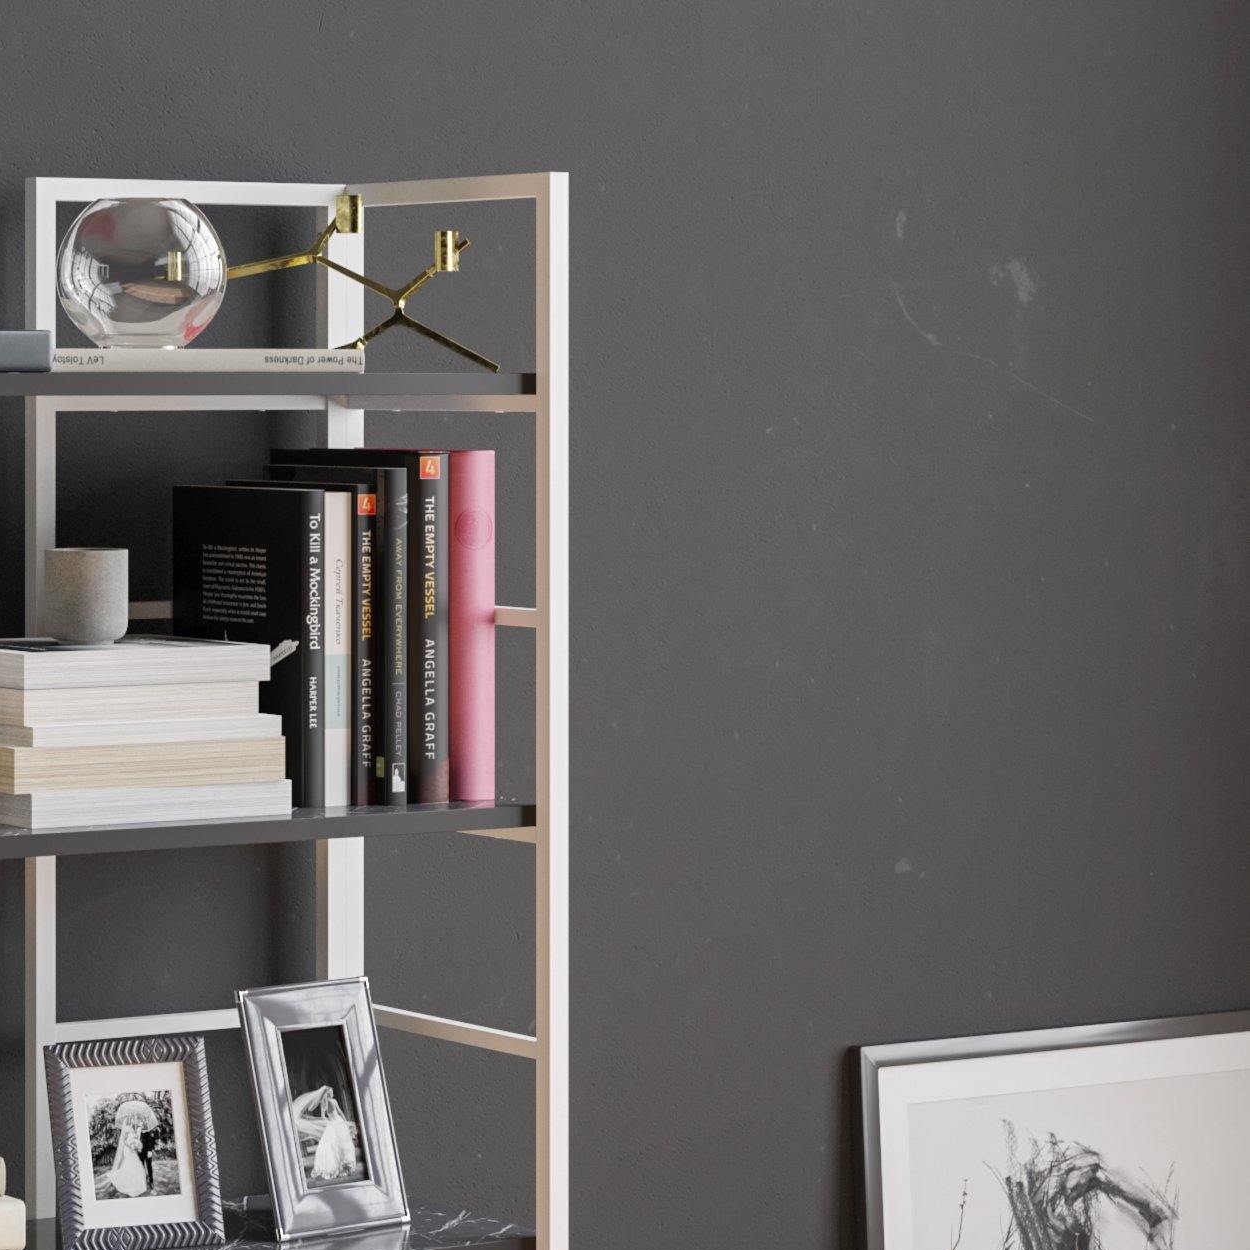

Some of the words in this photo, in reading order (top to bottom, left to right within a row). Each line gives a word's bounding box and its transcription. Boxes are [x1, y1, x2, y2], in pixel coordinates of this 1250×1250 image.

[52, 355, 83, 365] Tolstoy
[264, 355, 303, 365] Darkness
[305, 355, 315, 365] of
[325, 355, 344, 365] Power
[347, 355, 363, 365] The
[425, 459, 436, 475] 4
[309, 513, 321, 529] To
[425, 496, 435, 521] THE
[309, 532, 321, 552] Kill
[361, 530, 371, 553] THE
[395, 538, 403, 567] AWAY
[425, 525, 435, 569] EMPTY
[361, 556, 371, 595] EMPTY
[395, 569, 403, 600] FROM
[306, 568, 321, 650] Mockingbird
[425, 571, 435, 619] VESSEL
[361, 596, 371, 641] VESSEL
[395, 603, 403, 675] EVERYWHERE
[425, 639, 435, 706] ANGELLA
[309, 677, 318, 712] HARPER
[361, 658, 371, 719] ANGELLA
[309, 713, 318, 729] LEE
[425, 712, 435, 760] GRAFF
[361, 725, 371, 767] GRAFF
